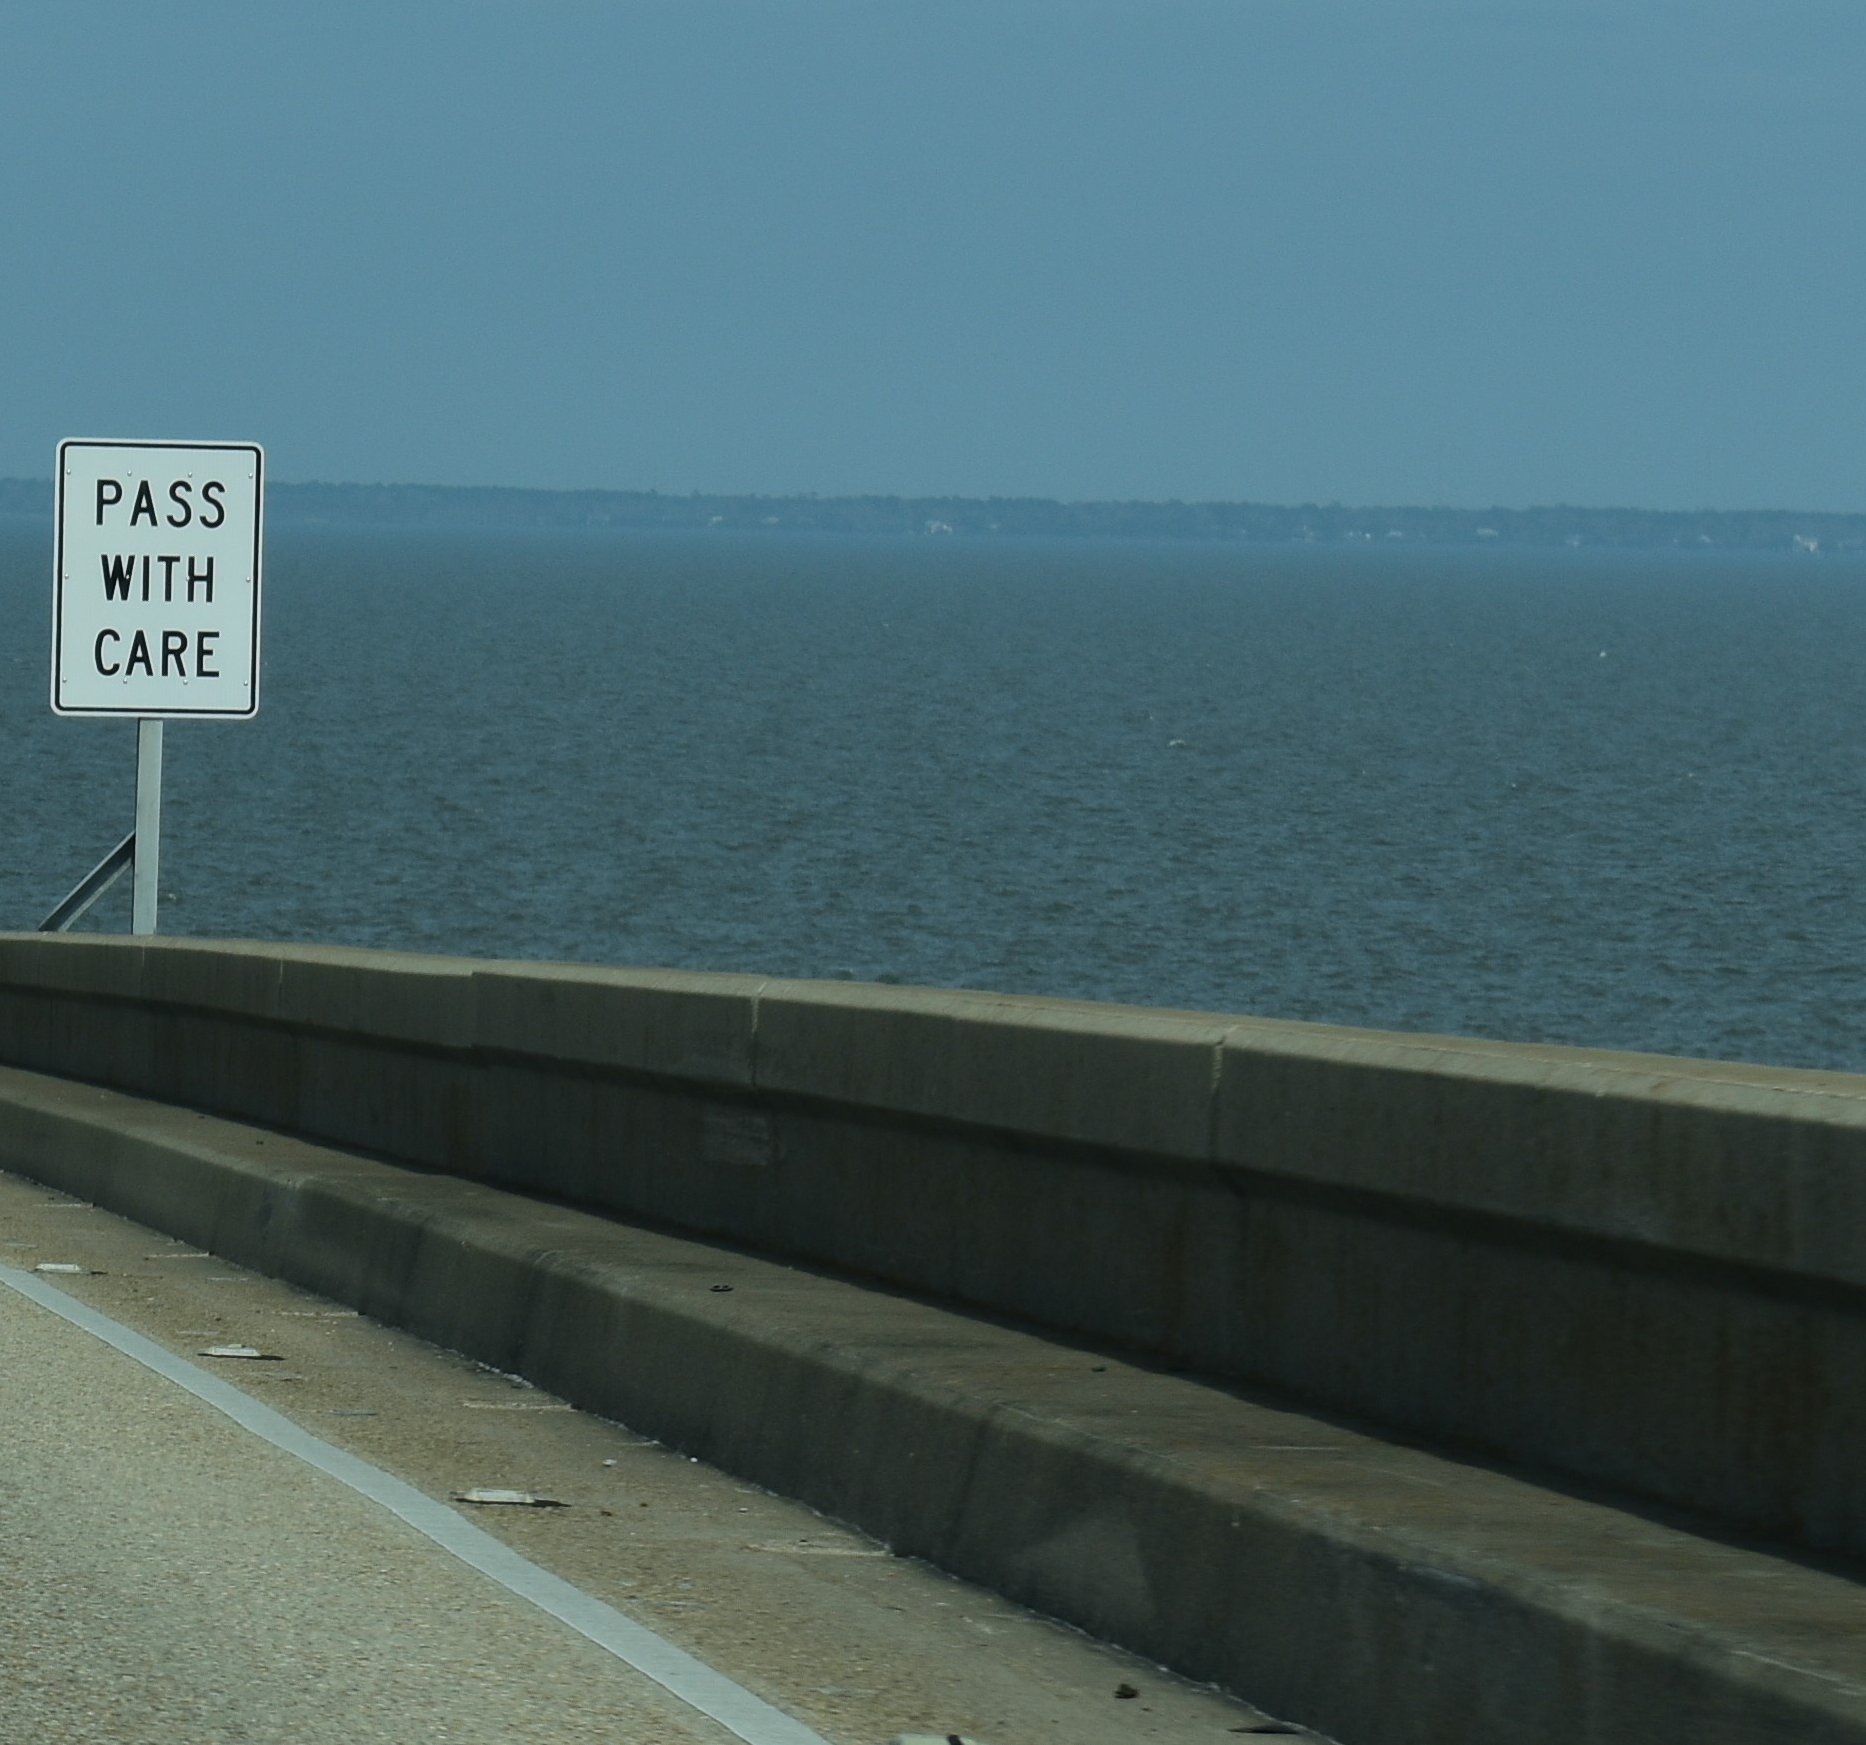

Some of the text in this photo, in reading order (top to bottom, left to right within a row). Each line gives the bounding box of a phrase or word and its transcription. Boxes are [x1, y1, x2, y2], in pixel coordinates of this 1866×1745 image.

[95, 479, 225, 528] PASS
[100, 554, 214, 602] WITH
[94, 628, 220, 677] CARE
